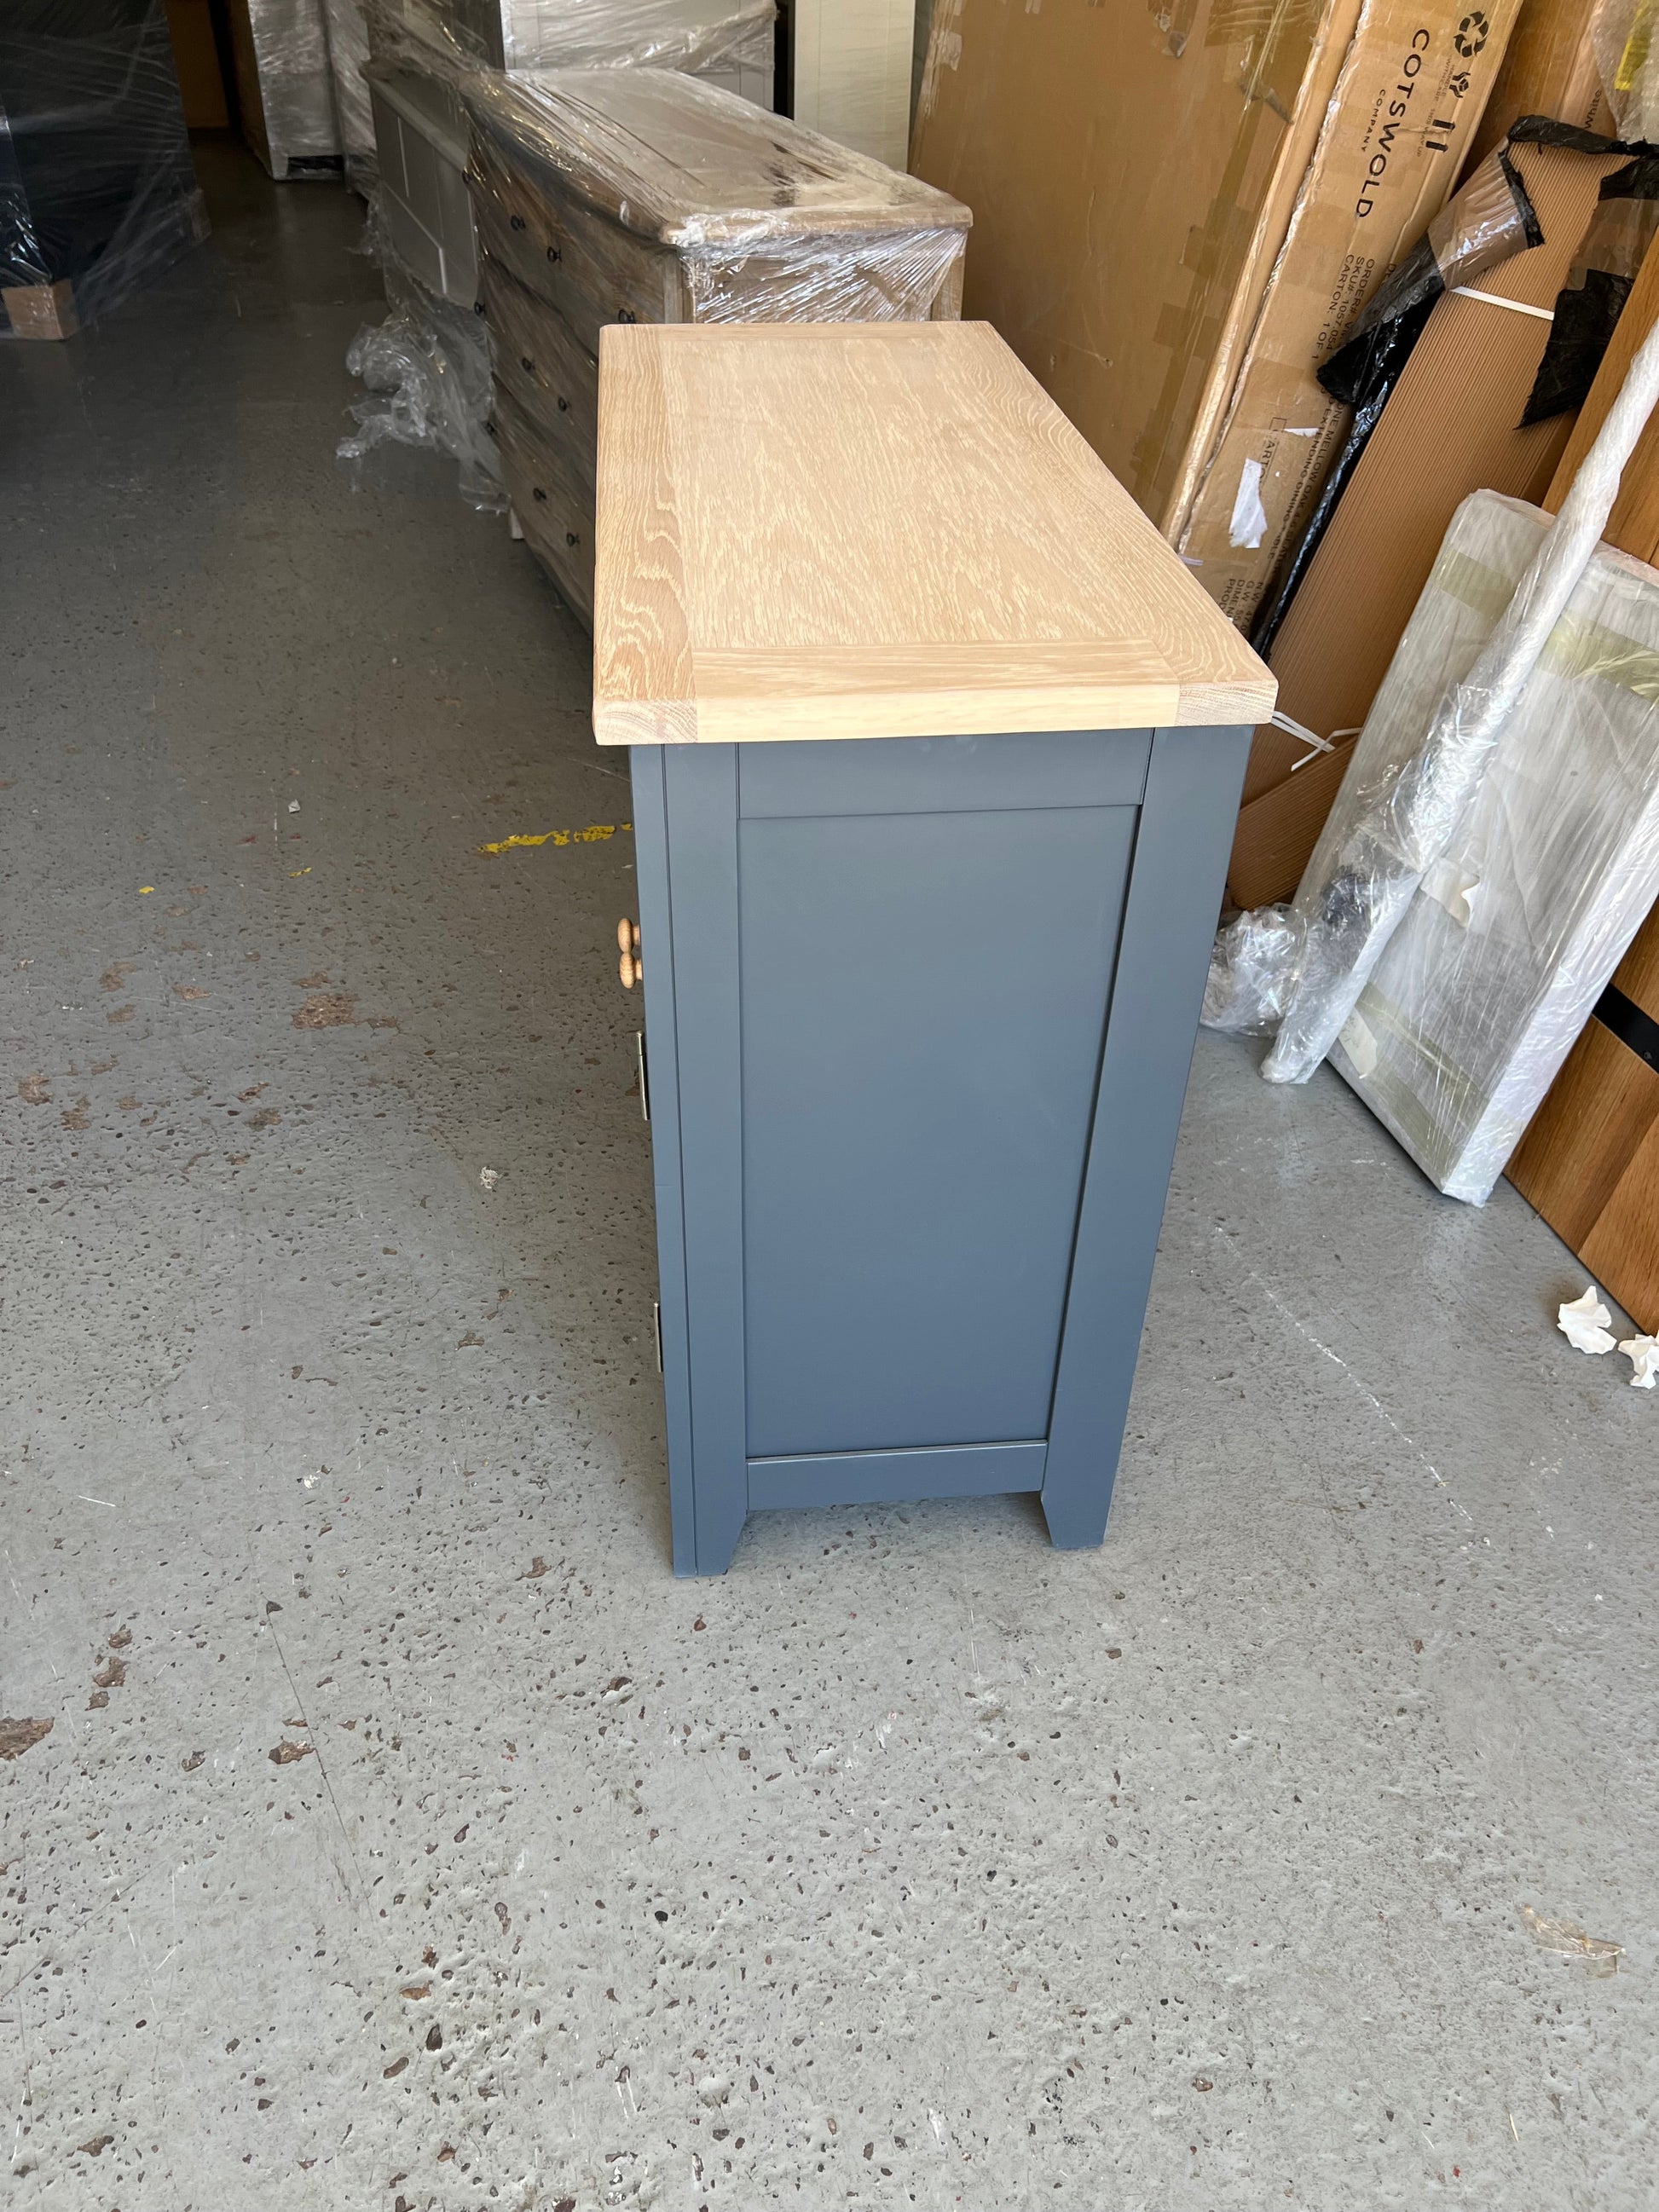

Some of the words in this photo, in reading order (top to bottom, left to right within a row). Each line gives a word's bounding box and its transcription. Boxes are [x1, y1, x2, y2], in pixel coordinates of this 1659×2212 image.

[1356, 29, 1430, 217] COTSWOLD
[1361, 89, 1386, 152] COMPANY
[1327, 254, 1354, 314] CARTON:
[1316, 332, 1327, 349] OF
[1300, 408, 1332, 478] EXTENDING
[1309, 430, 1334, 482] MELLOW
[1283, 482, 1304, 523] DINING
[1297, 485, 1311, 509] OAK
[1227, 580, 1246, 617] DIMEN
